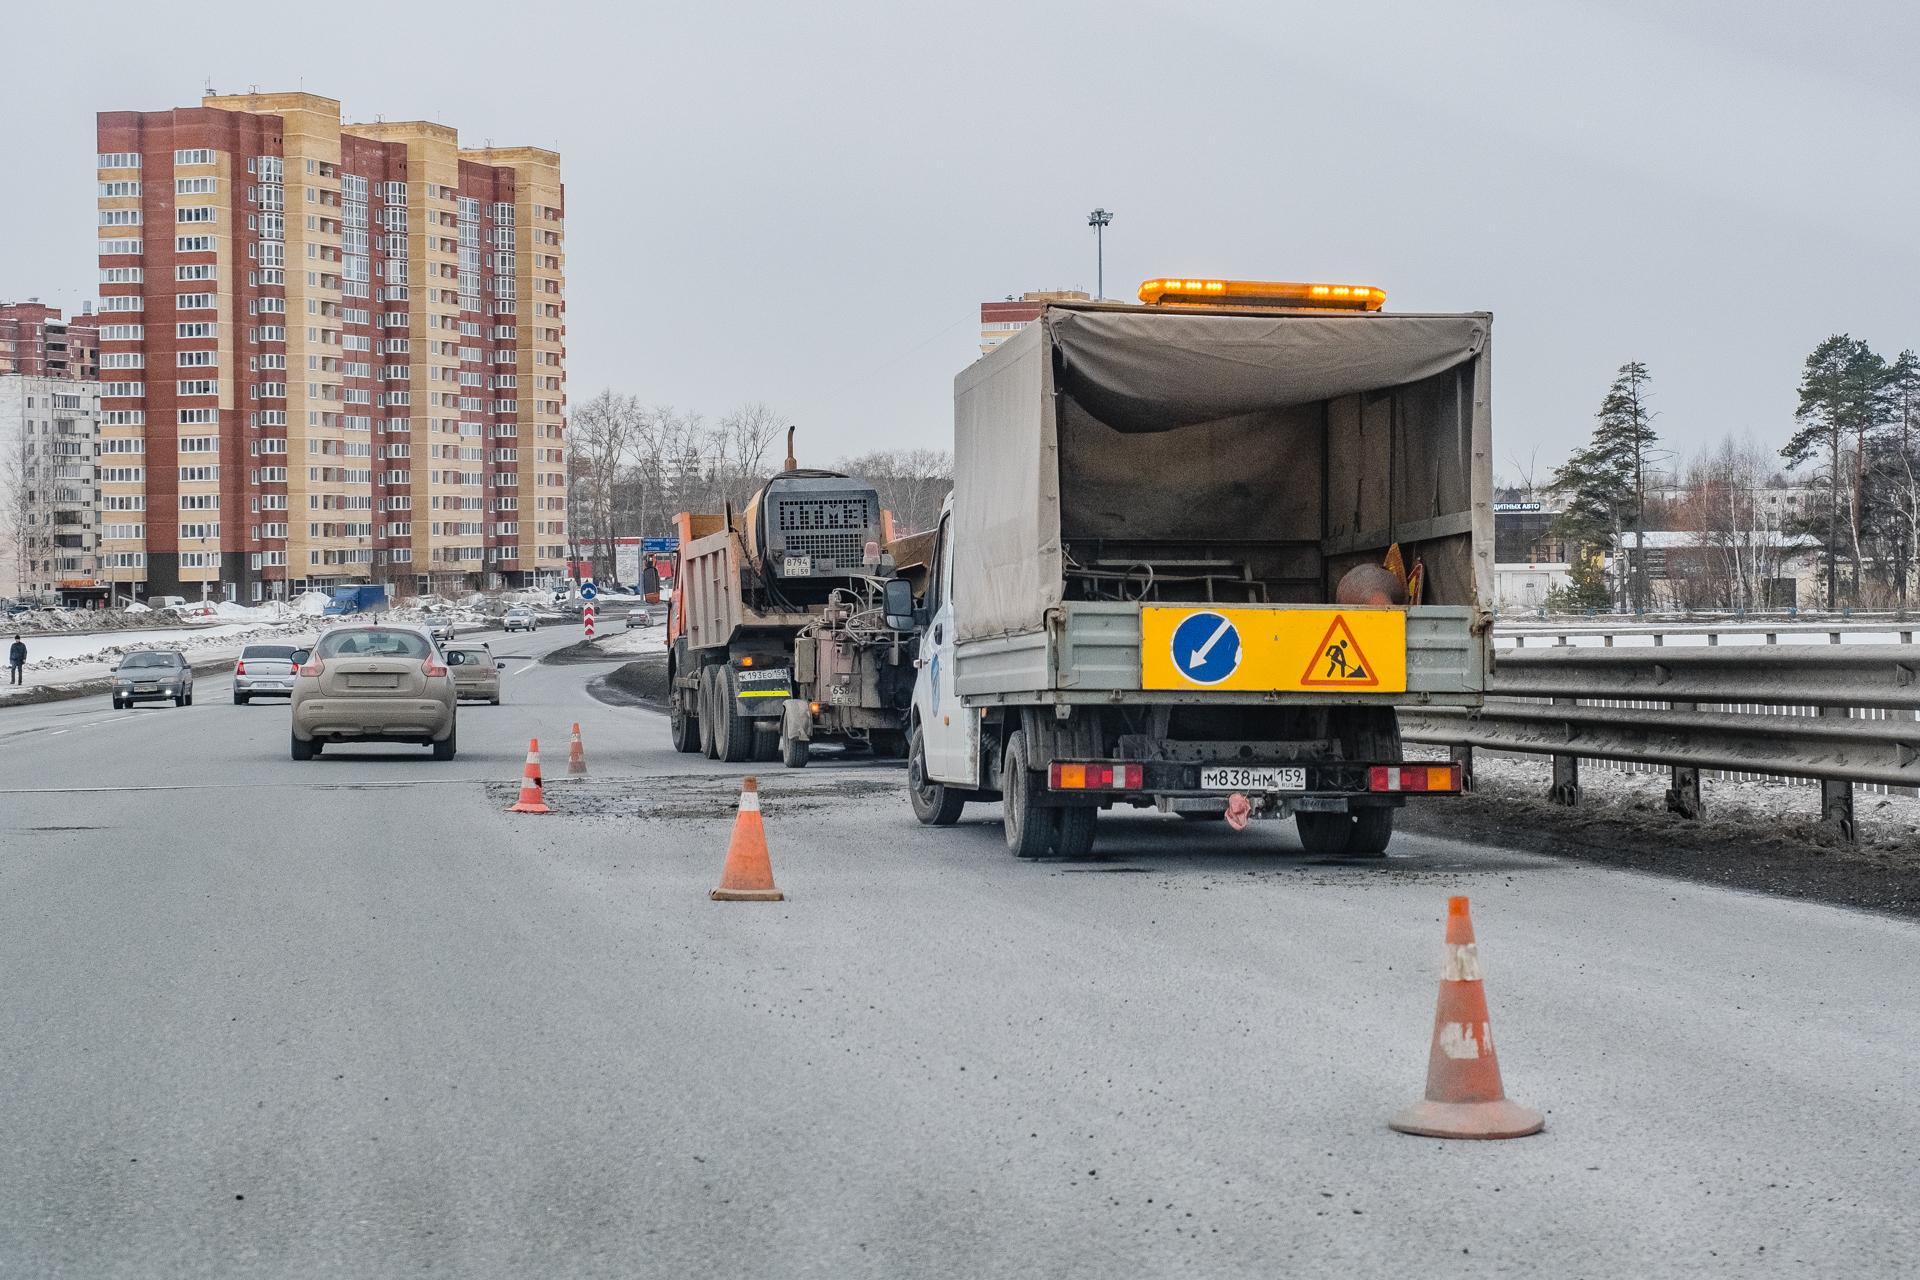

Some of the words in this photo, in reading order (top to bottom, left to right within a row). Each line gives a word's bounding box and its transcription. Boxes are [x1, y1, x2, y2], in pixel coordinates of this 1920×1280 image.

[786, 558, 808, 567] 8794
[1207, 769, 1273, 787] М838НМ
[1277, 769, 1301, 783] 159
